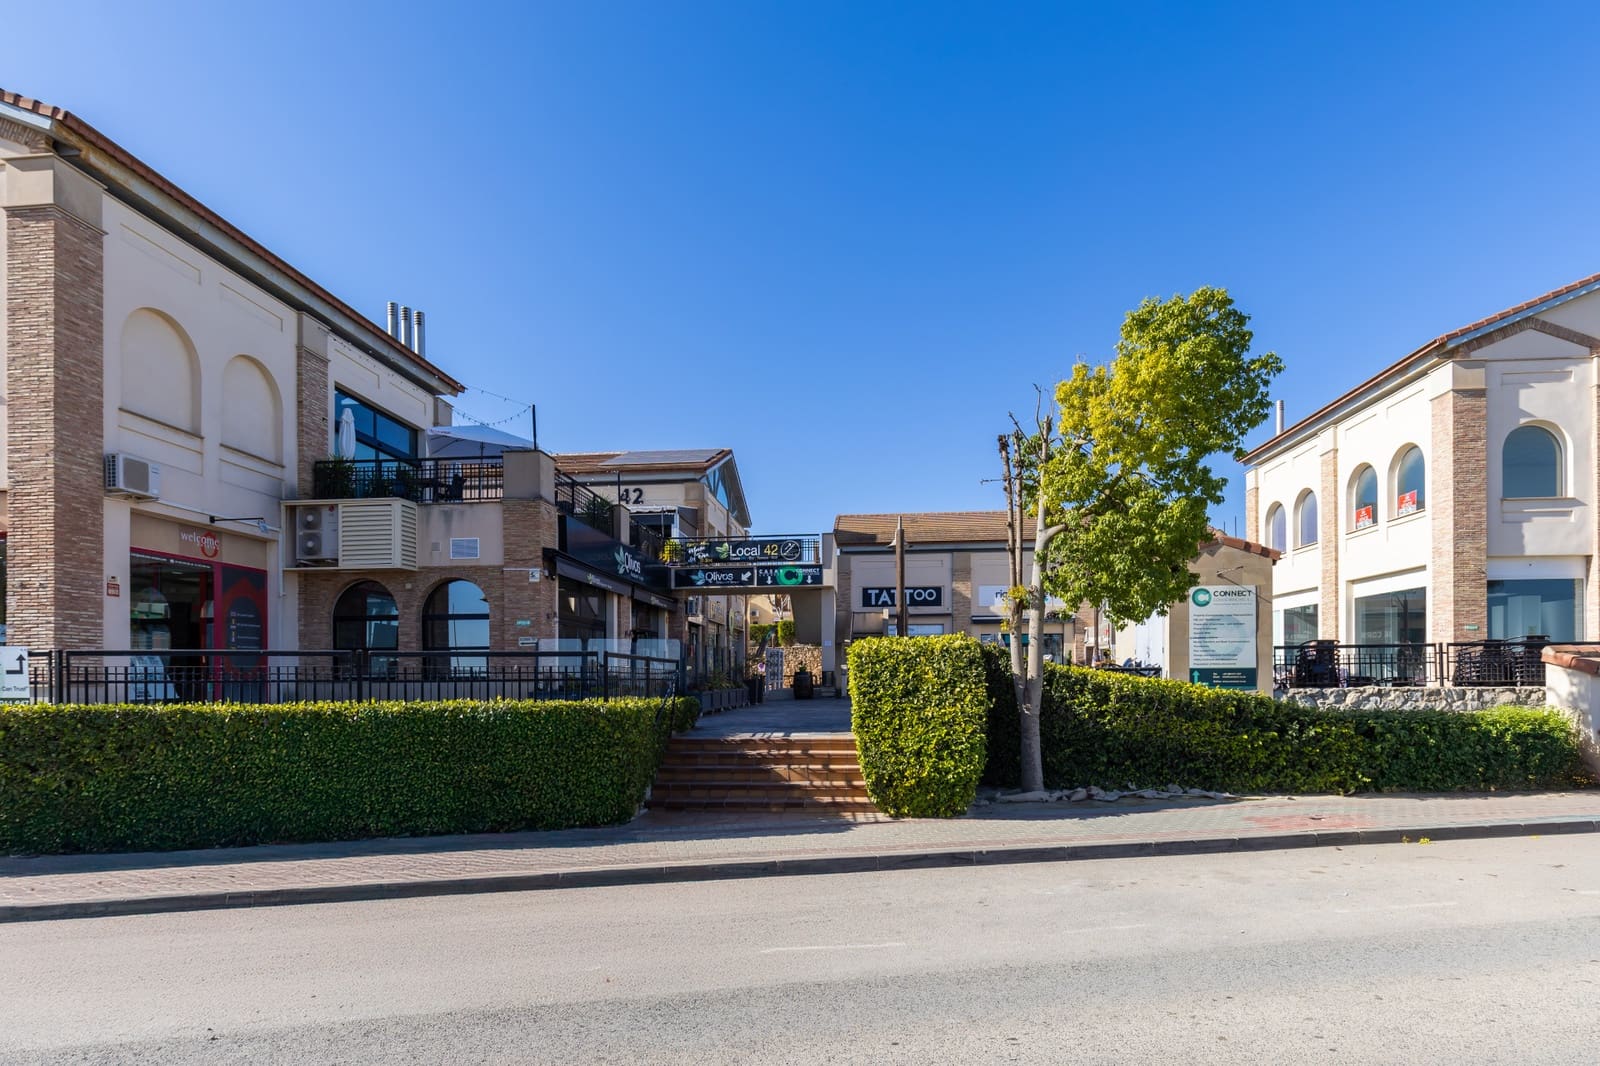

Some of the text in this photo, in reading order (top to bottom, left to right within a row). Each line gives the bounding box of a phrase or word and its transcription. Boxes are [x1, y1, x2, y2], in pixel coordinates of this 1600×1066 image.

[620, 488, 644, 504] 42
[180, 531, 220, 547] welcome
[729, 544, 778, 557] Local 42
[867, 589, 937, 605] TATTOO
[1213, 590, 1252, 598] CONNECT
